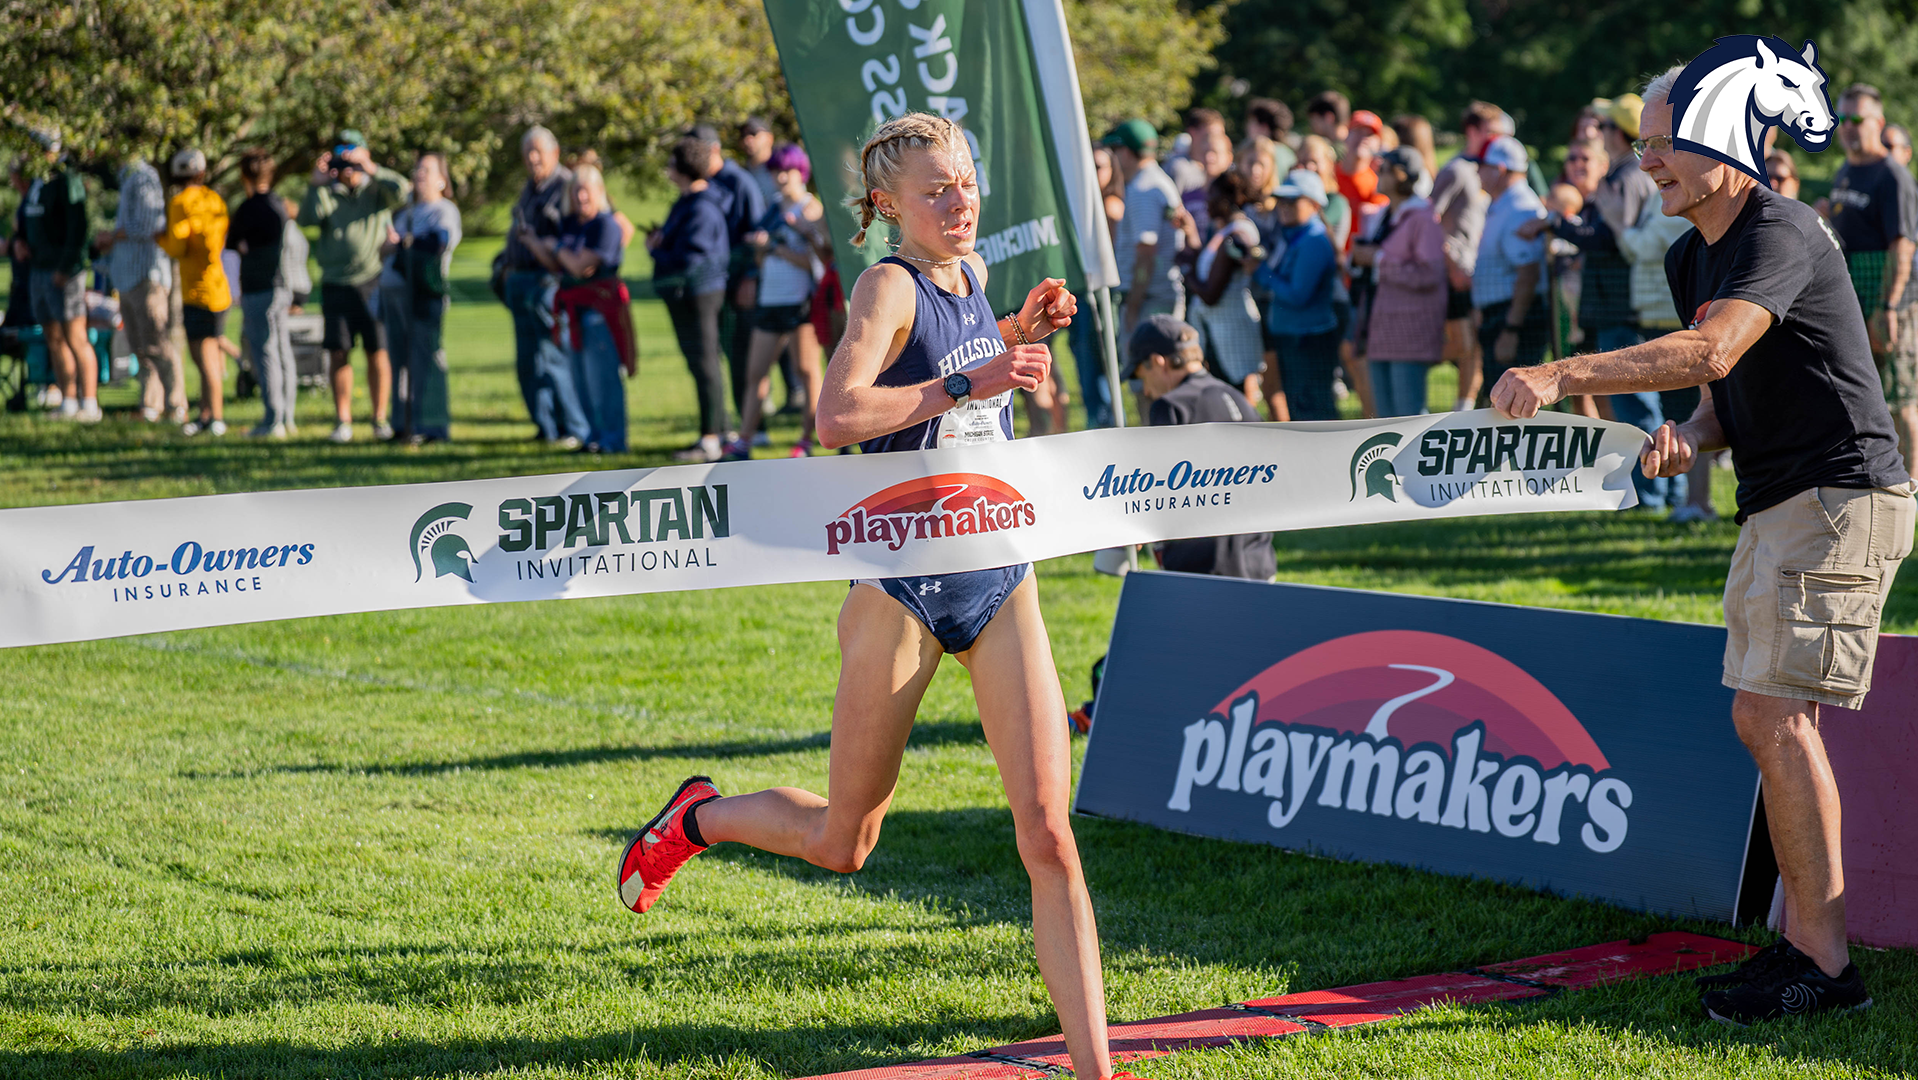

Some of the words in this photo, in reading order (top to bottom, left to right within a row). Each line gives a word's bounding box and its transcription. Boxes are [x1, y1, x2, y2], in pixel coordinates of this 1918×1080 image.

[1417, 425, 1606, 476] SPARTAN
[1083, 460, 1278, 500] Auto-Owners
[1430, 476, 1583, 501] INVITATIONAL
[498, 484, 730, 553] SPARTAN
[1125, 492, 1232, 515] INSURANCE
[825, 497, 1036, 556] playmakers
[41, 541, 315, 585] Auto-Owners
[517, 548, 717, 581] INVITATIONAL
[113, 576, 262, 602] INSURANCE
[1167, 690, 1633, 854] playmakers
